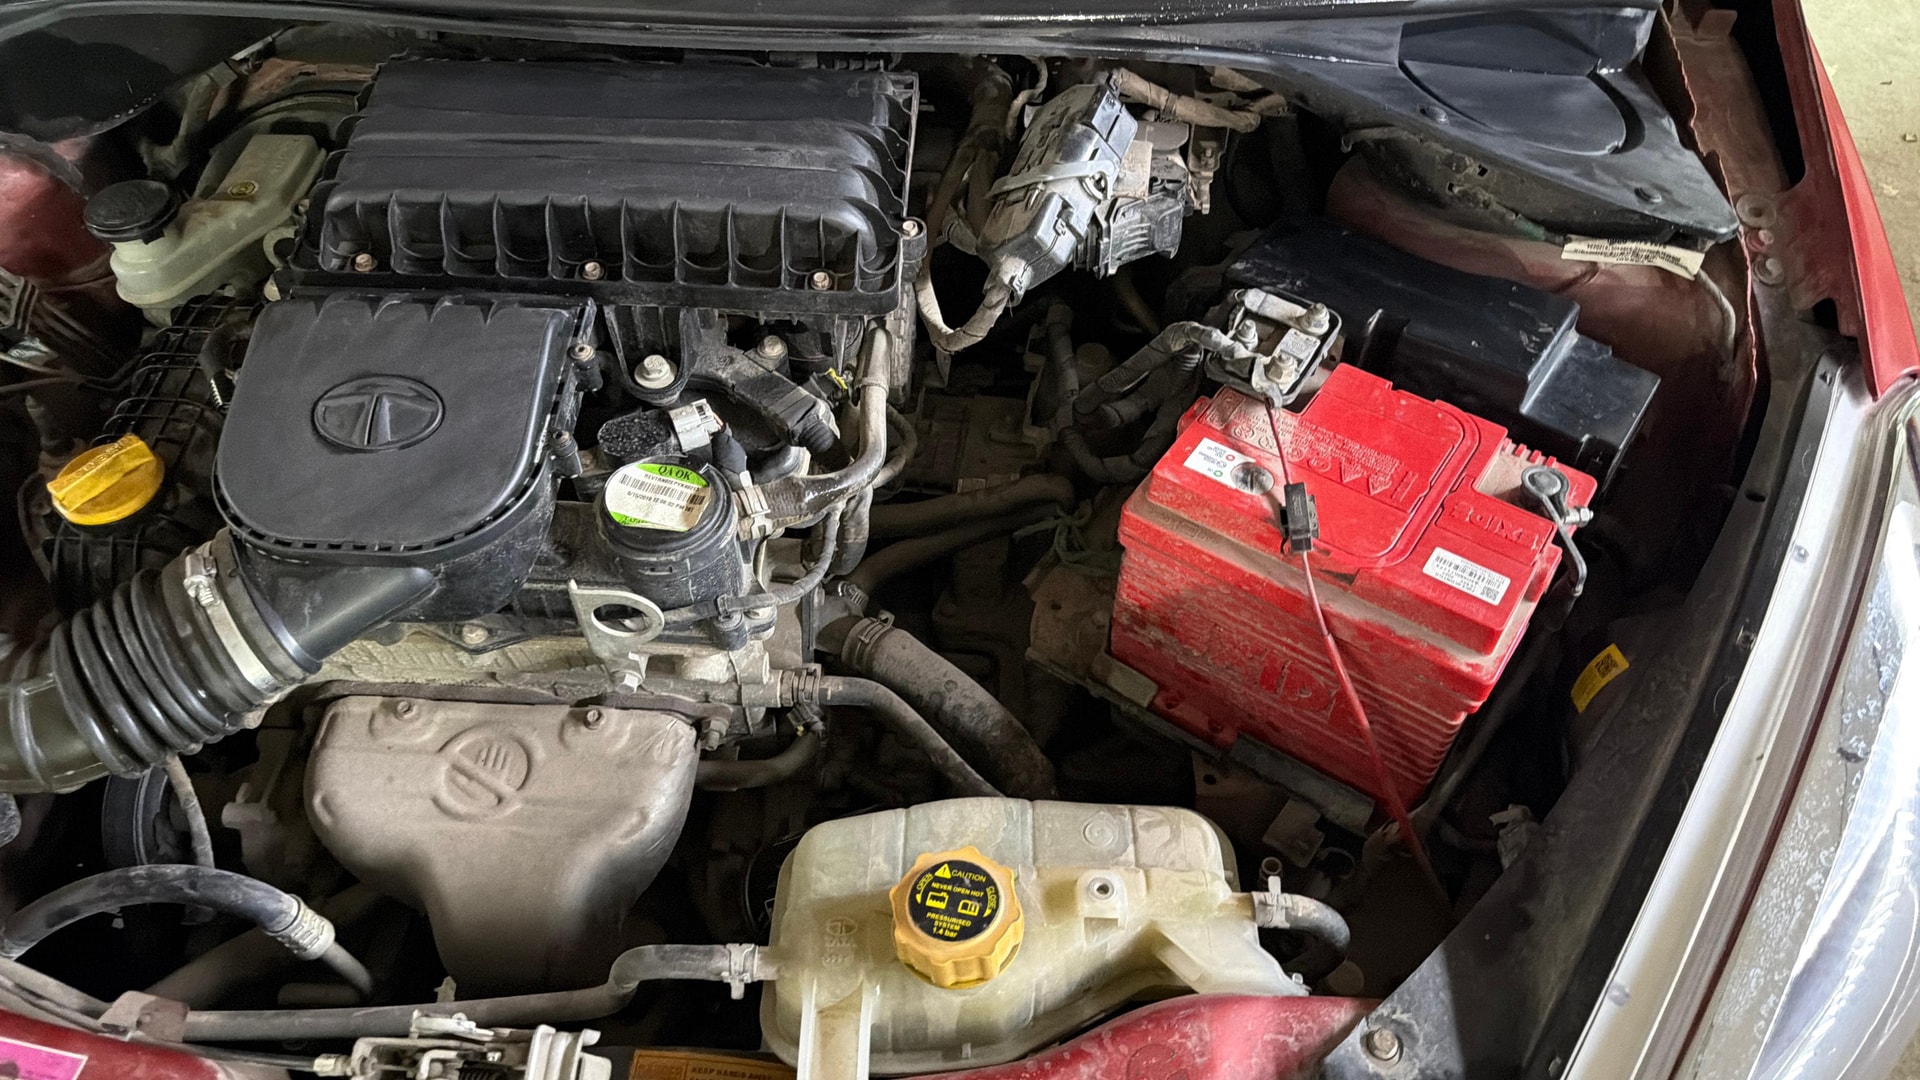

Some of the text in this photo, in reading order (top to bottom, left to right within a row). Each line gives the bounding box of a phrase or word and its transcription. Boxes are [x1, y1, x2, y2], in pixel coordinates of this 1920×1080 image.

[658, 465, 692, 481] QA OK
[916, 872, 934, 890] OPEN
[951, 869, 987, 883] CAUTION
[931, 882, 953, 891] NEVER
[952, 887, 970, 897] OPEN
[987, 885, 997, 909] CLOSE
[926, 911, 972, 927] PRESSURISED
[933, 920, 961, 931] SYSTEM
[933, 926, 958, 938] 1.4 bar
[691, 1066, 717, 1074] KEEP
[718, 1069, 746, 1078] HANDS
